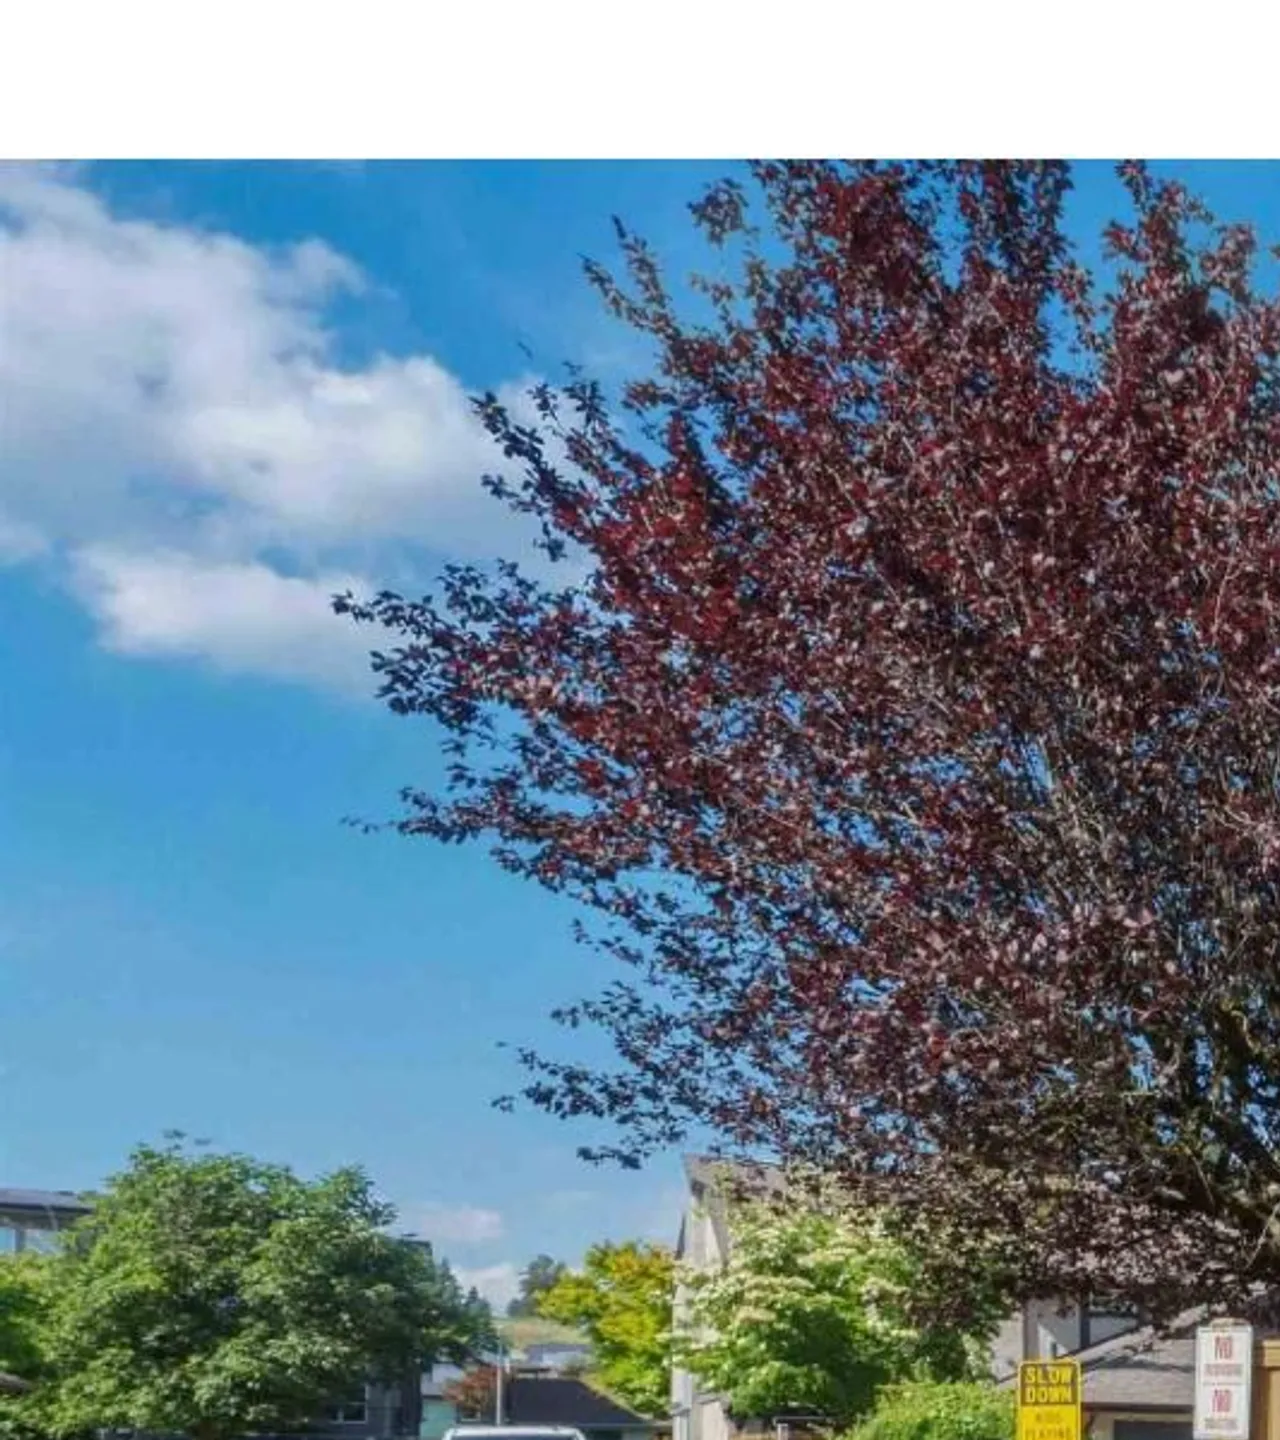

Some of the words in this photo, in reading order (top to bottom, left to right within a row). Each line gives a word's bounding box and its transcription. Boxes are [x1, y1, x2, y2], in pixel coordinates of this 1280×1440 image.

[1213, 1336, 1233, 1359] NO
[1024, 1366, 1073, 1385] SLOW
[1024, 1386, 1073, 1403] DOWN
[1212, 1389, 1231, 1413] NO
